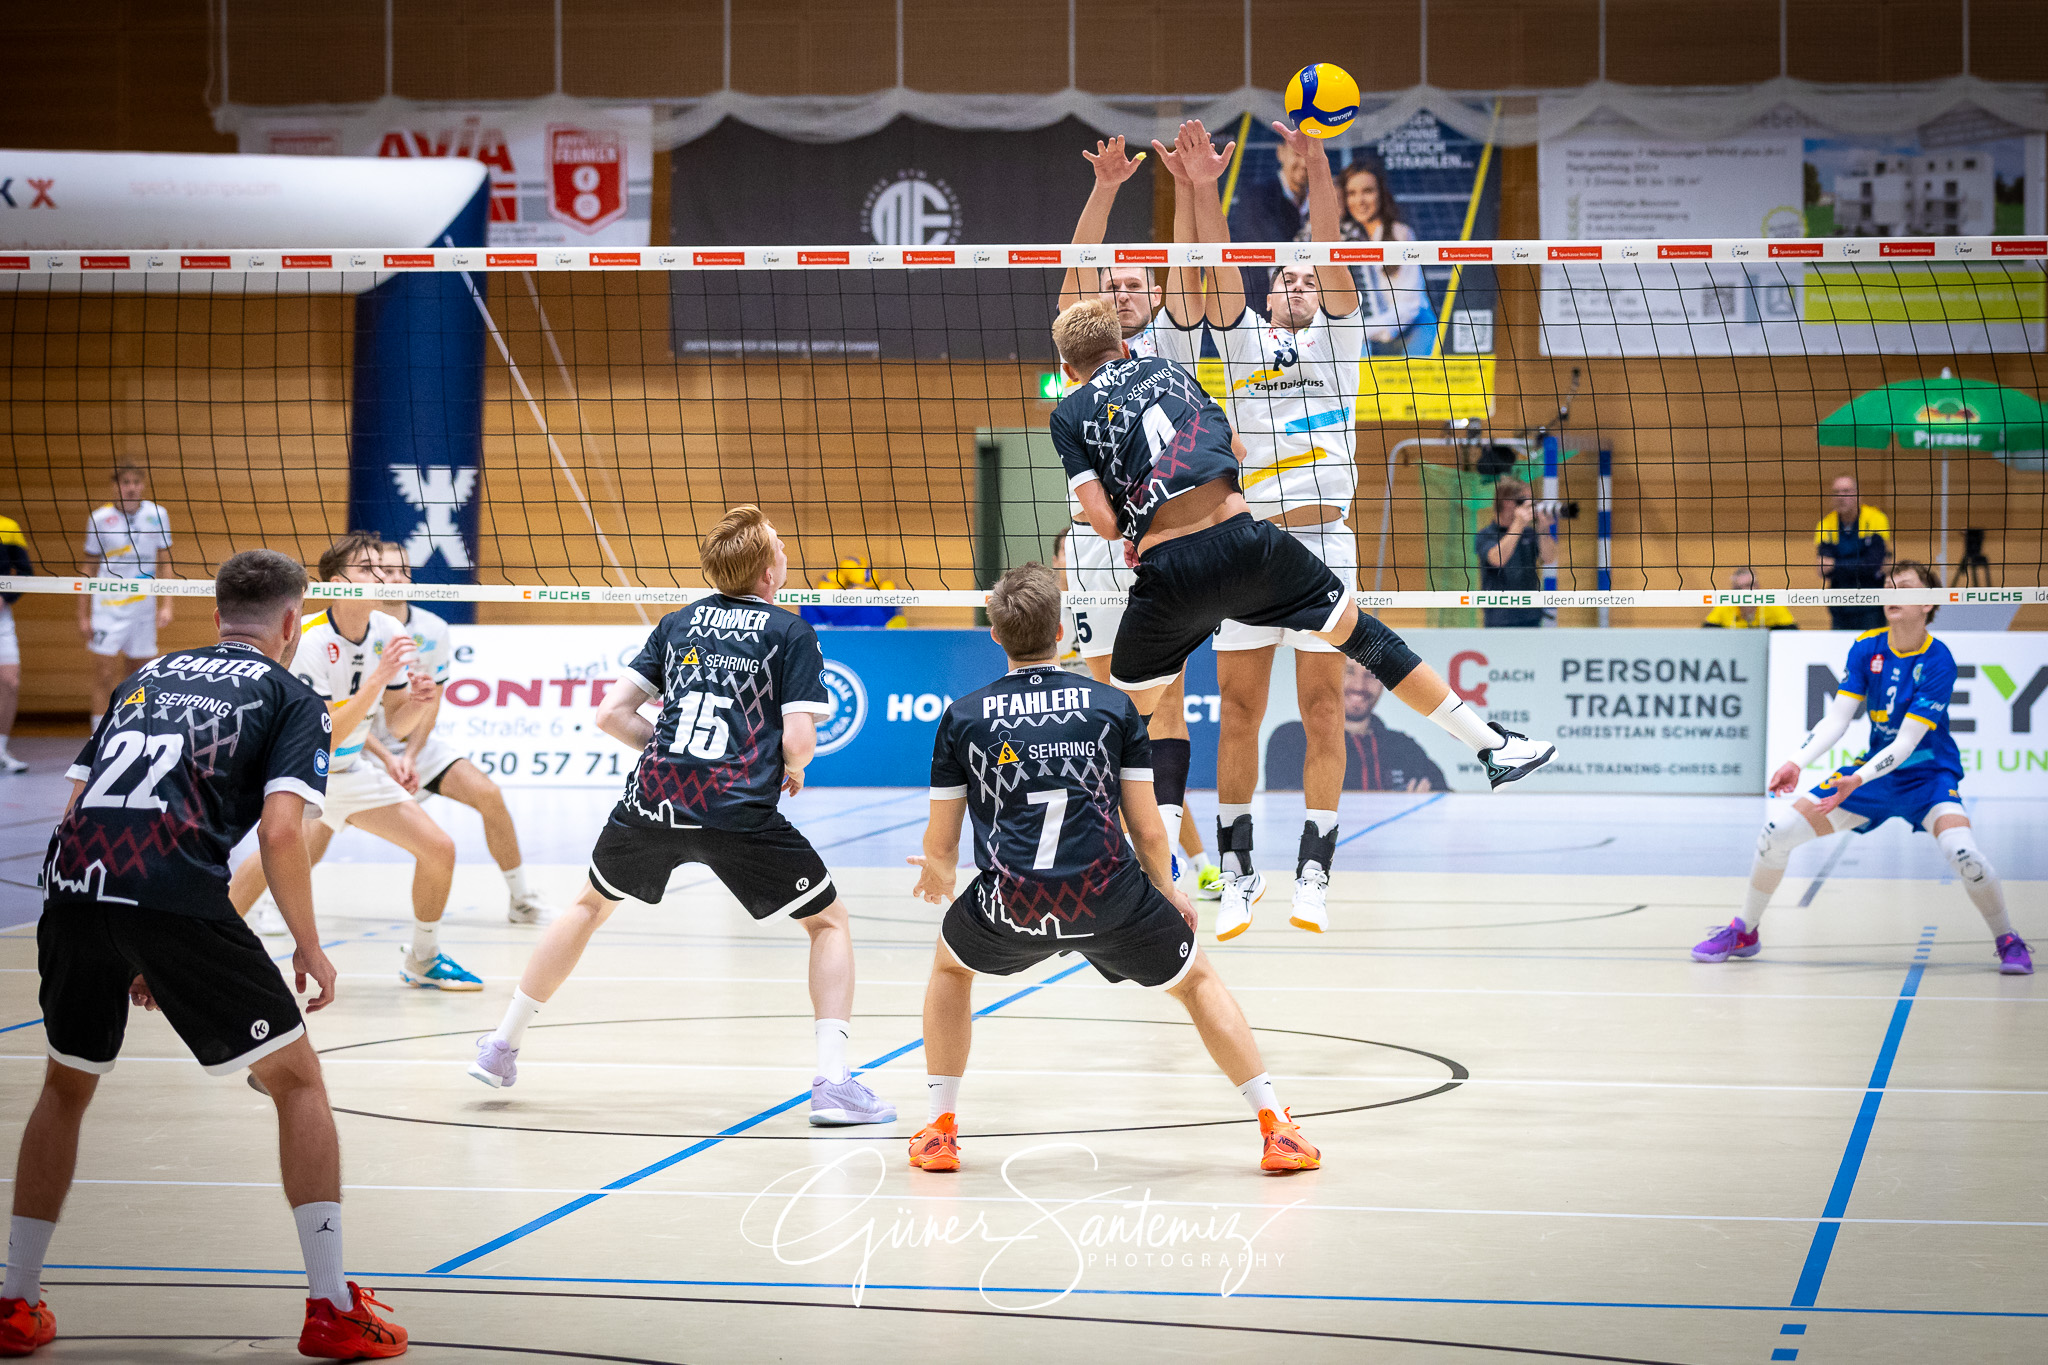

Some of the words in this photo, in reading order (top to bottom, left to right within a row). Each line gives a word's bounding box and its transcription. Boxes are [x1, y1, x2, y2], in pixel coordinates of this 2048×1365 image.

[88, 582, 139, 592] FUCHS
[150, 583, 179, 594] Ideen
[312, 587, 363, 597] FUCHS
[374, 588, 403, 599] Ideen
[406, 589, 460, 600] umsetzen
[538, 590, 590, 600] FUCHS
[601, 591, 633, 602] Ideen
[635, 592, 688, 602] umsetzen
[1966, 592, 2023, 602] FUCHS
[832, 594, 864, 605] Ideen
[866, 595, 920, 605] umsetzen
[1066, 595, 1097, 606] Ideen
[1477, 595, 1532, 606] FUCHS
[1543, 595, 1575, 606] Ideen
[1578, 595, 1635, 606] umsetzen
[1719, 594, 1775, 605] FUCHS
[1787, 593, 1819, 605] Ideen
[1823, 593, 1881, 604] umsetzen
[166, 654, 272, 681] CARTER
[704, 653, 760, 674] SEHRING
[1561, 658, 1748, 683] PERSONAL
[154, 692, 233, 718] SEHRING
[982, 687, 1092, 720] PFAHLERT
[1565, 693, 1743, 718] TRAINING
[668, 690, 735, 760] 15
[1556, 725, 1656, 740] CHRISTIAN
[1028, 741, 1096, 760] SEHRING
[81, 730, 184, 813] 22
[532, 752, 571, 776] 57
[586, 752, 622, 776] 71
[1026, 787, 1069, 871] 7
